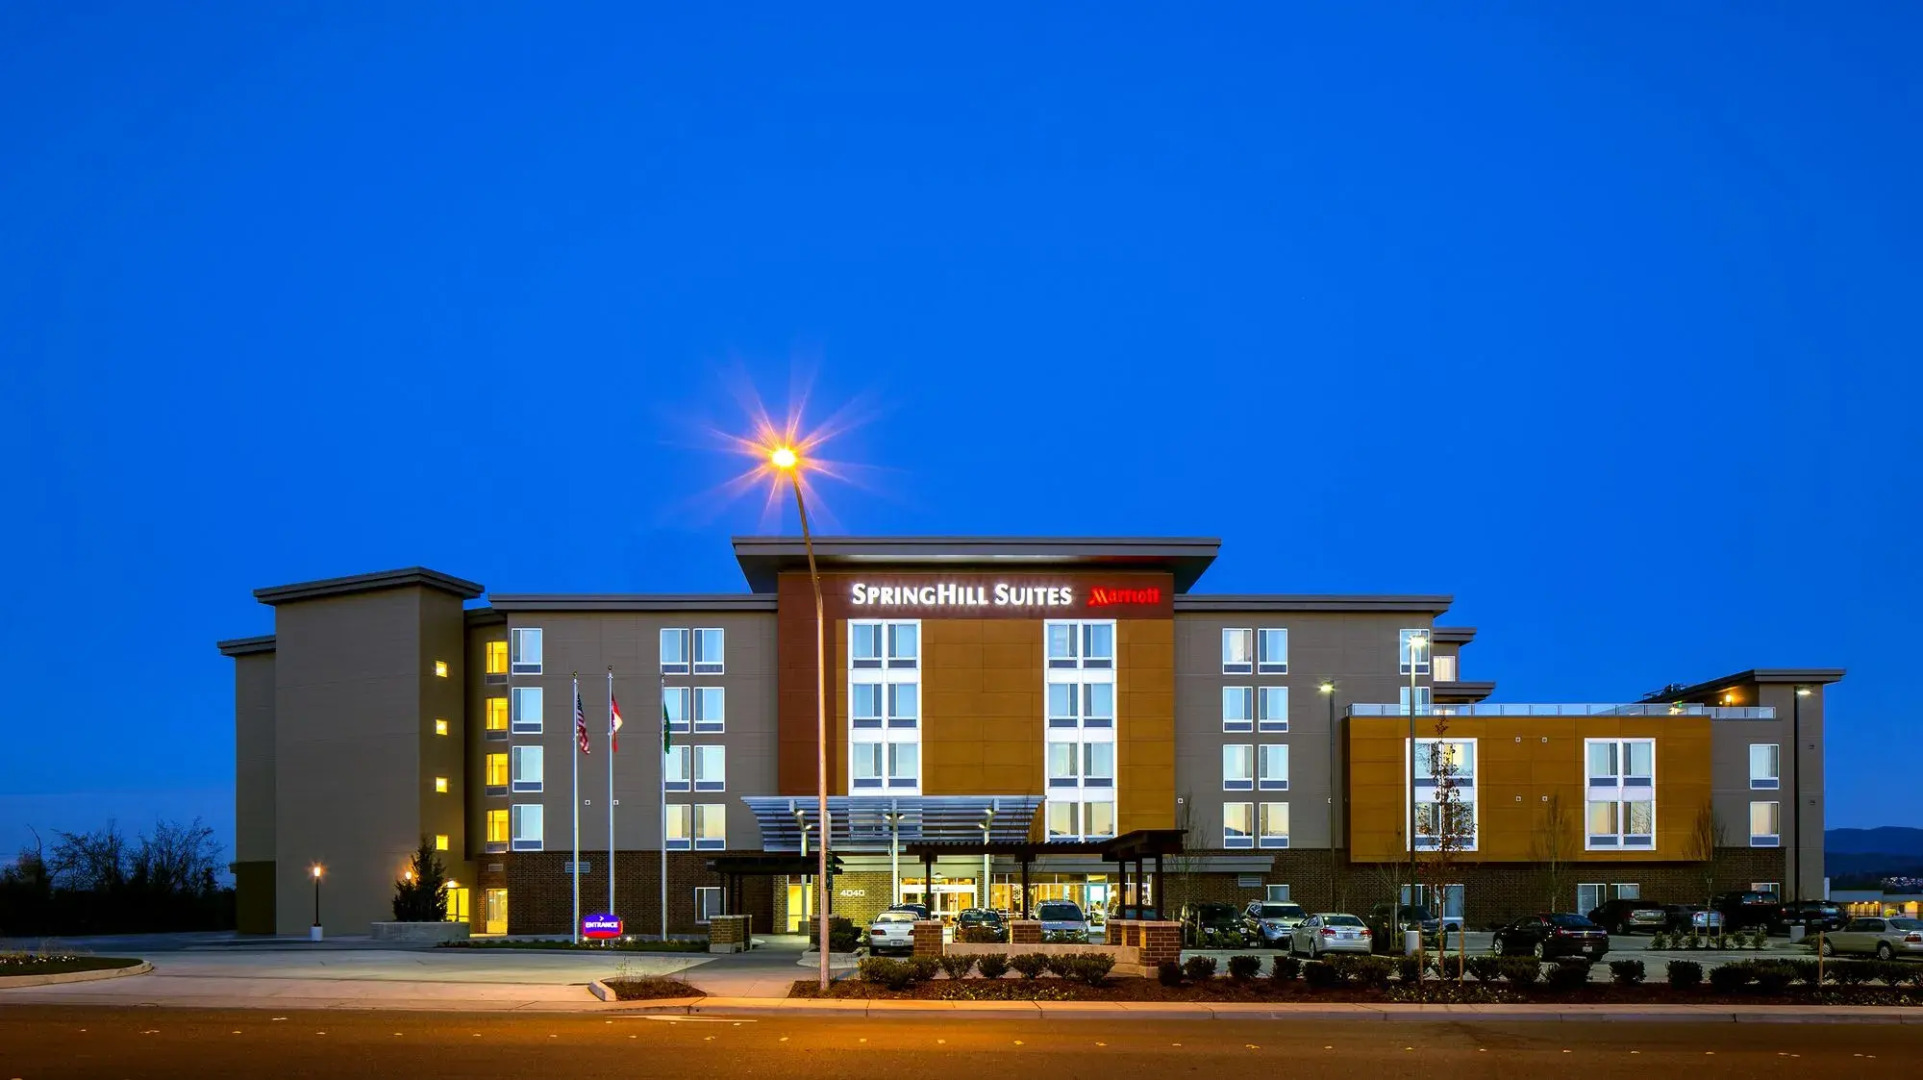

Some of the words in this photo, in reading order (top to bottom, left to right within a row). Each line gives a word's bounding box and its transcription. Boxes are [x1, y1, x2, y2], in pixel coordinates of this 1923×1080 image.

[994, 583, 1073, 605] SUITES
[1088, 587, 1160, 606] Marriott
[840, 889, 865, 897] 4040
